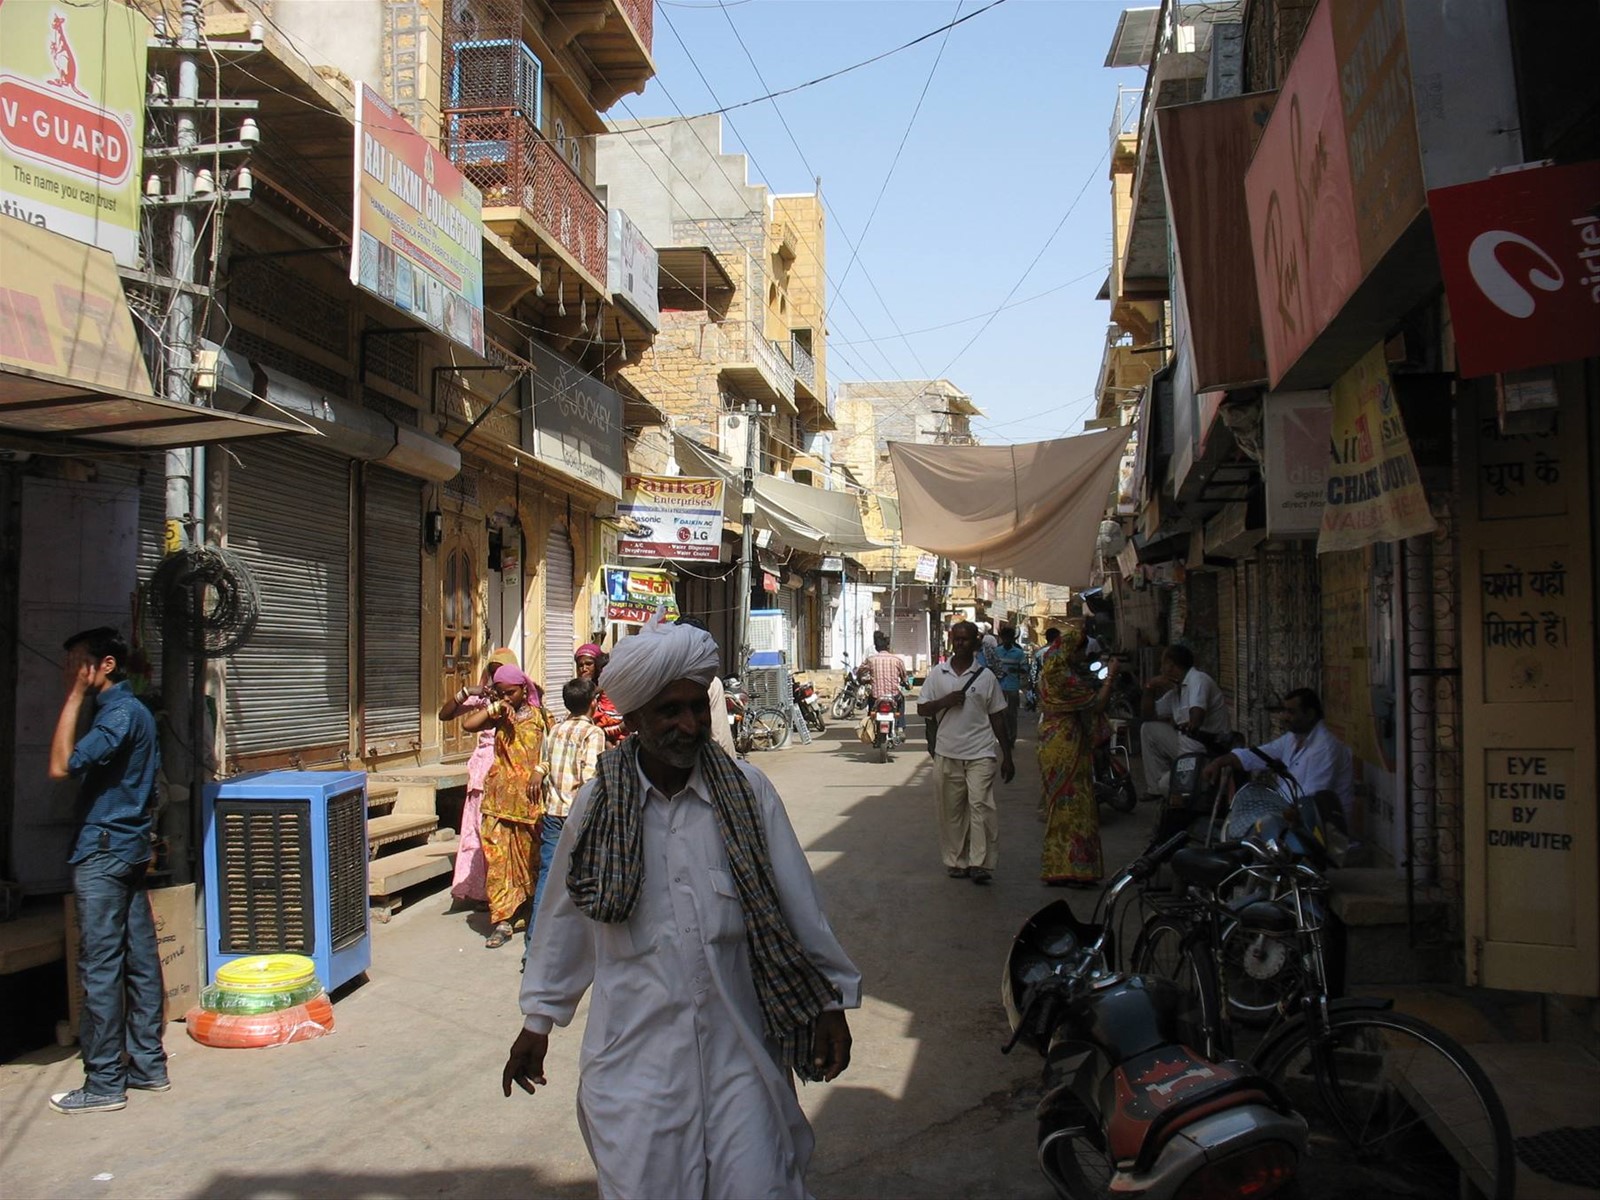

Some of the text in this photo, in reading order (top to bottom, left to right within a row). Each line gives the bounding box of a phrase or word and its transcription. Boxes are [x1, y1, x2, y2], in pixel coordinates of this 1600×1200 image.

[1, 97, 122, 163] V-GUARD
[13, 165, 117, 212] The name you can trust
[0, 199, 47, 228] tiva
[388, 151, 423, 215] LAXMI
[425, 182, 482, 262] COLLECTION
[624, 476, 715, 499] Pankaj
[654, 496, 713, 507] Enterprises
[693, 531, 709, 541] LG
[1507, 757, 1547, 776] EYE
[1487, 783, 1567, 800] TESTING
[1512, 807, 1538, 823] BY
[1487, 829, 1573, 852] COMPUTER
